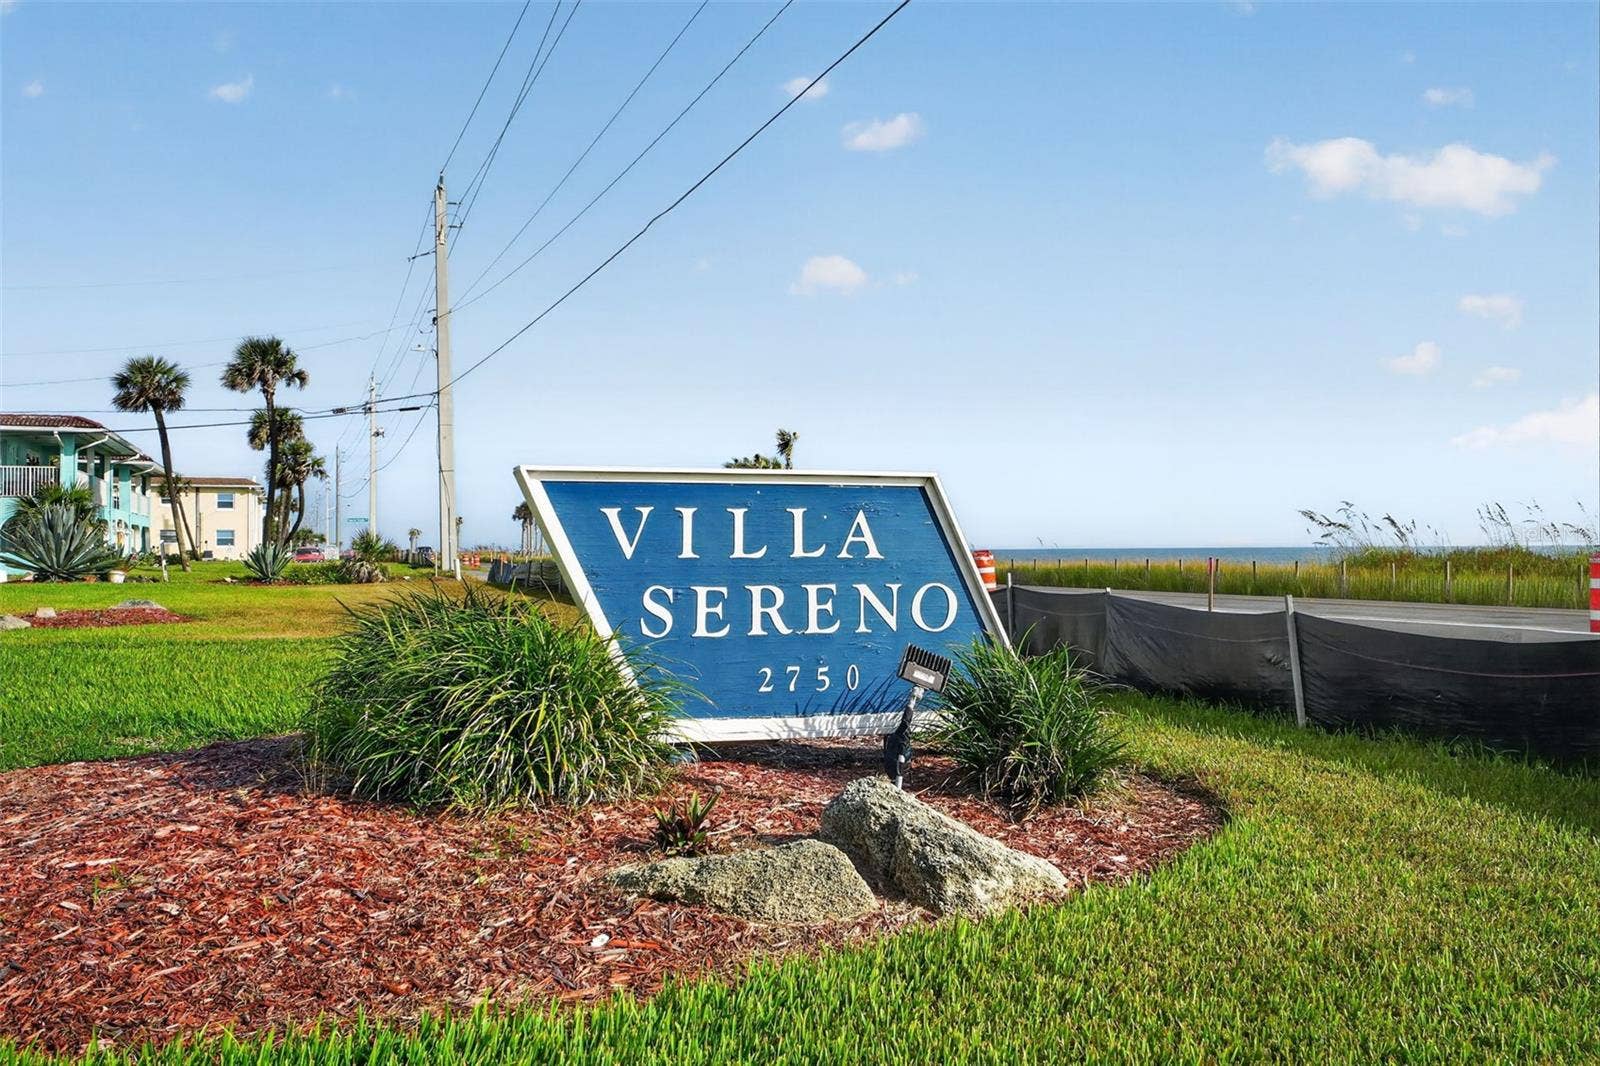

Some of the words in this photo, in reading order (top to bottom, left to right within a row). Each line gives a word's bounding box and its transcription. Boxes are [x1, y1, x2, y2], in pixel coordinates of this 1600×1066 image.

[599, 506, 885, 560] VILLA
[639, 582, 958, 639] SERENO
[757, 664, 860, 694] 2750
